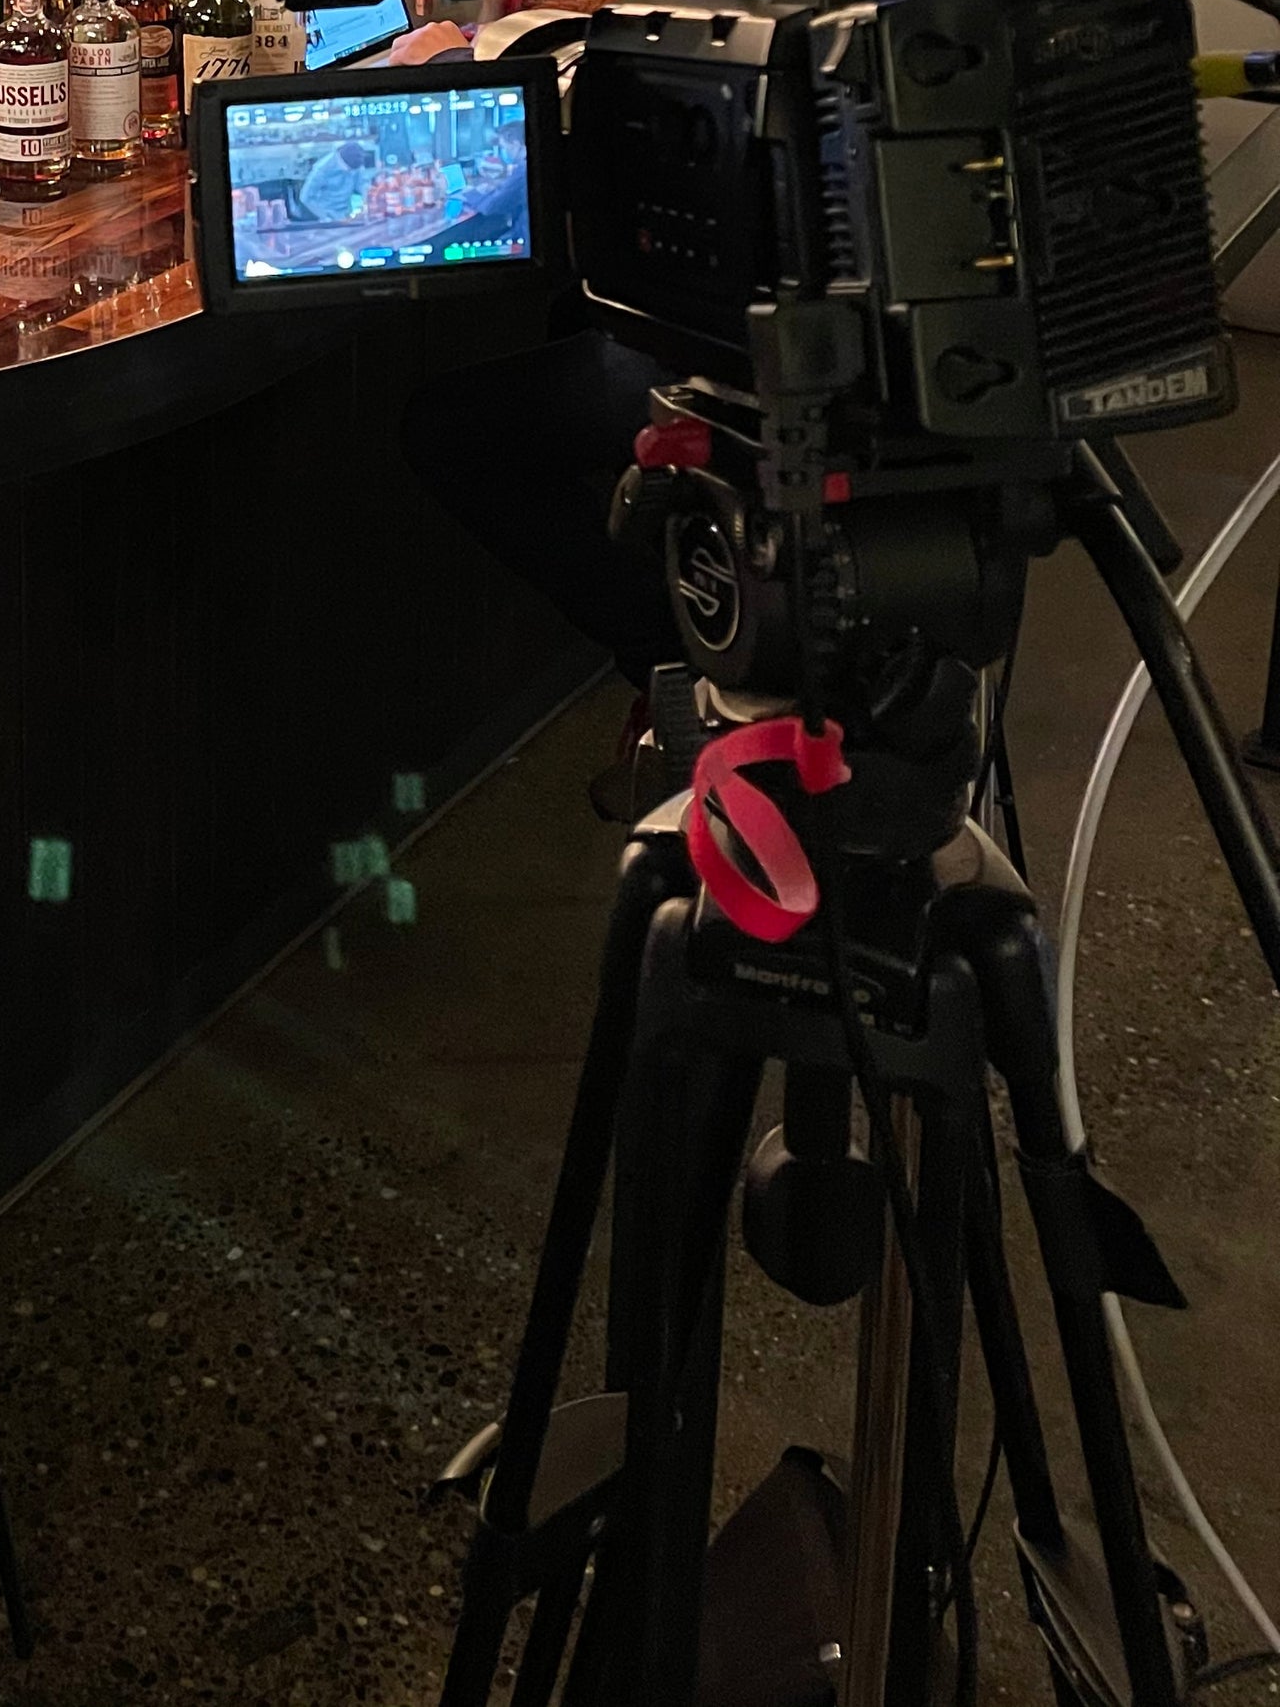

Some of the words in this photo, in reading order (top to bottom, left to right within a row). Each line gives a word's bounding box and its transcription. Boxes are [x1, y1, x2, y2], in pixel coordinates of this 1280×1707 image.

[71, 47, 88, 56] OLD
[71, 56, 111, 66] CABIN
[21, 139, 41, 156] 10
[1084, 367, 1208, 413] TANDEM
